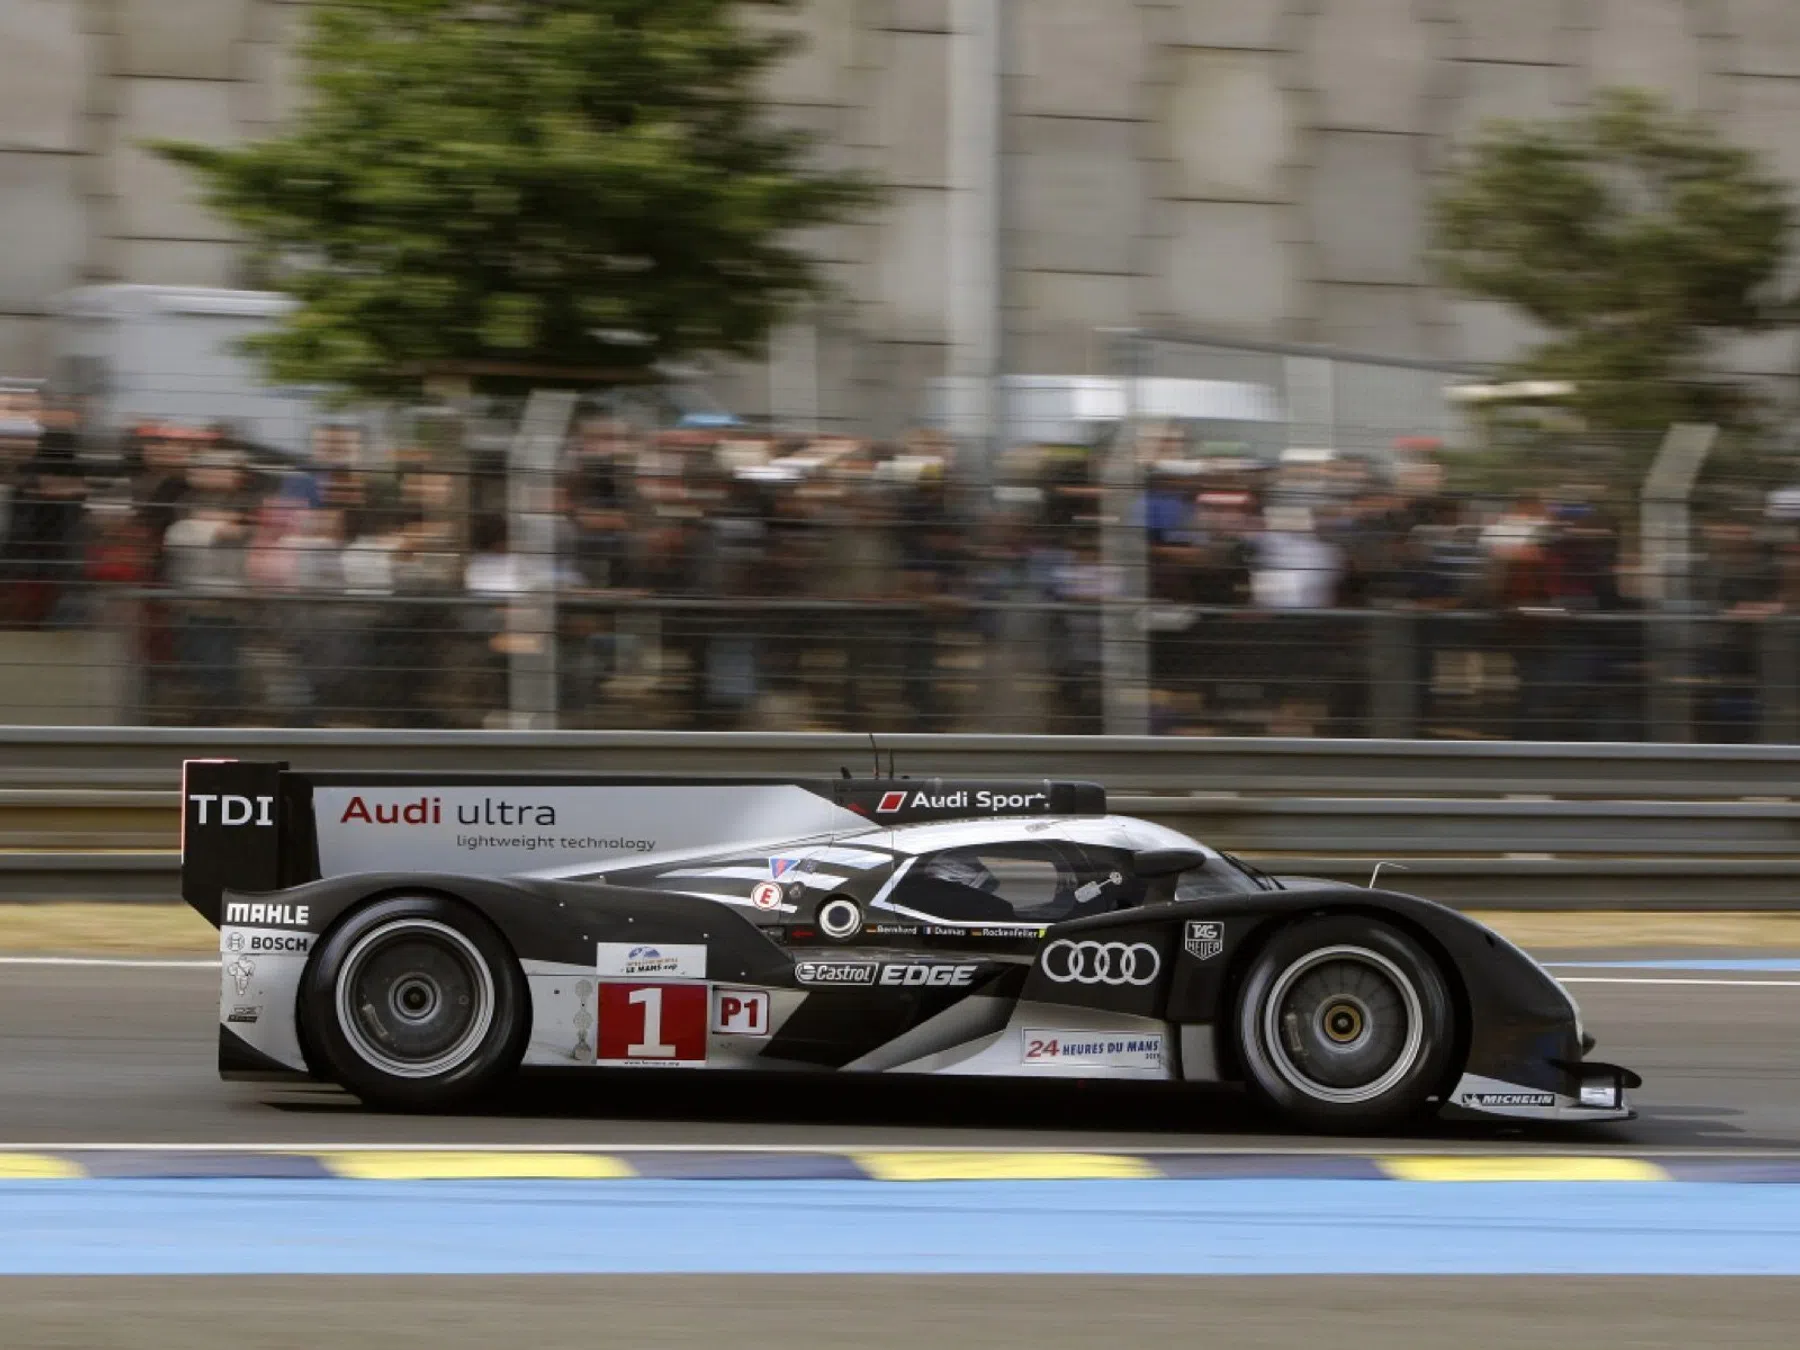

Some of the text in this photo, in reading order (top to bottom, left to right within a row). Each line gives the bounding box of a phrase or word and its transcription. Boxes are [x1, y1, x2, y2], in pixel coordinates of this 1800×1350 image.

[910, 791, 968, 808] Audi
[189, 794, 274, 826] TDI
[340, 796, 556, 826] Audi ultra
[456, 834, 656, 852] lightweight technology
[760, 888, 774, 905] E
[226, 903, 310, 926] MAHLE
[1191, 924, 1218, 939] TAG
[251, 936, 309, 952] BOSCH
[1187, 941, 1220, 958] HEUER
[816, 963, 978, 986] Castrol EDGE
[721, 997, 760, 1028] P1
[627, 987, 677, 1058] 1
[1025, 1039, 1159, 1058] 24 HEURES DU MANS
[1482, 1094, 1553, 1104] MICHELIN
